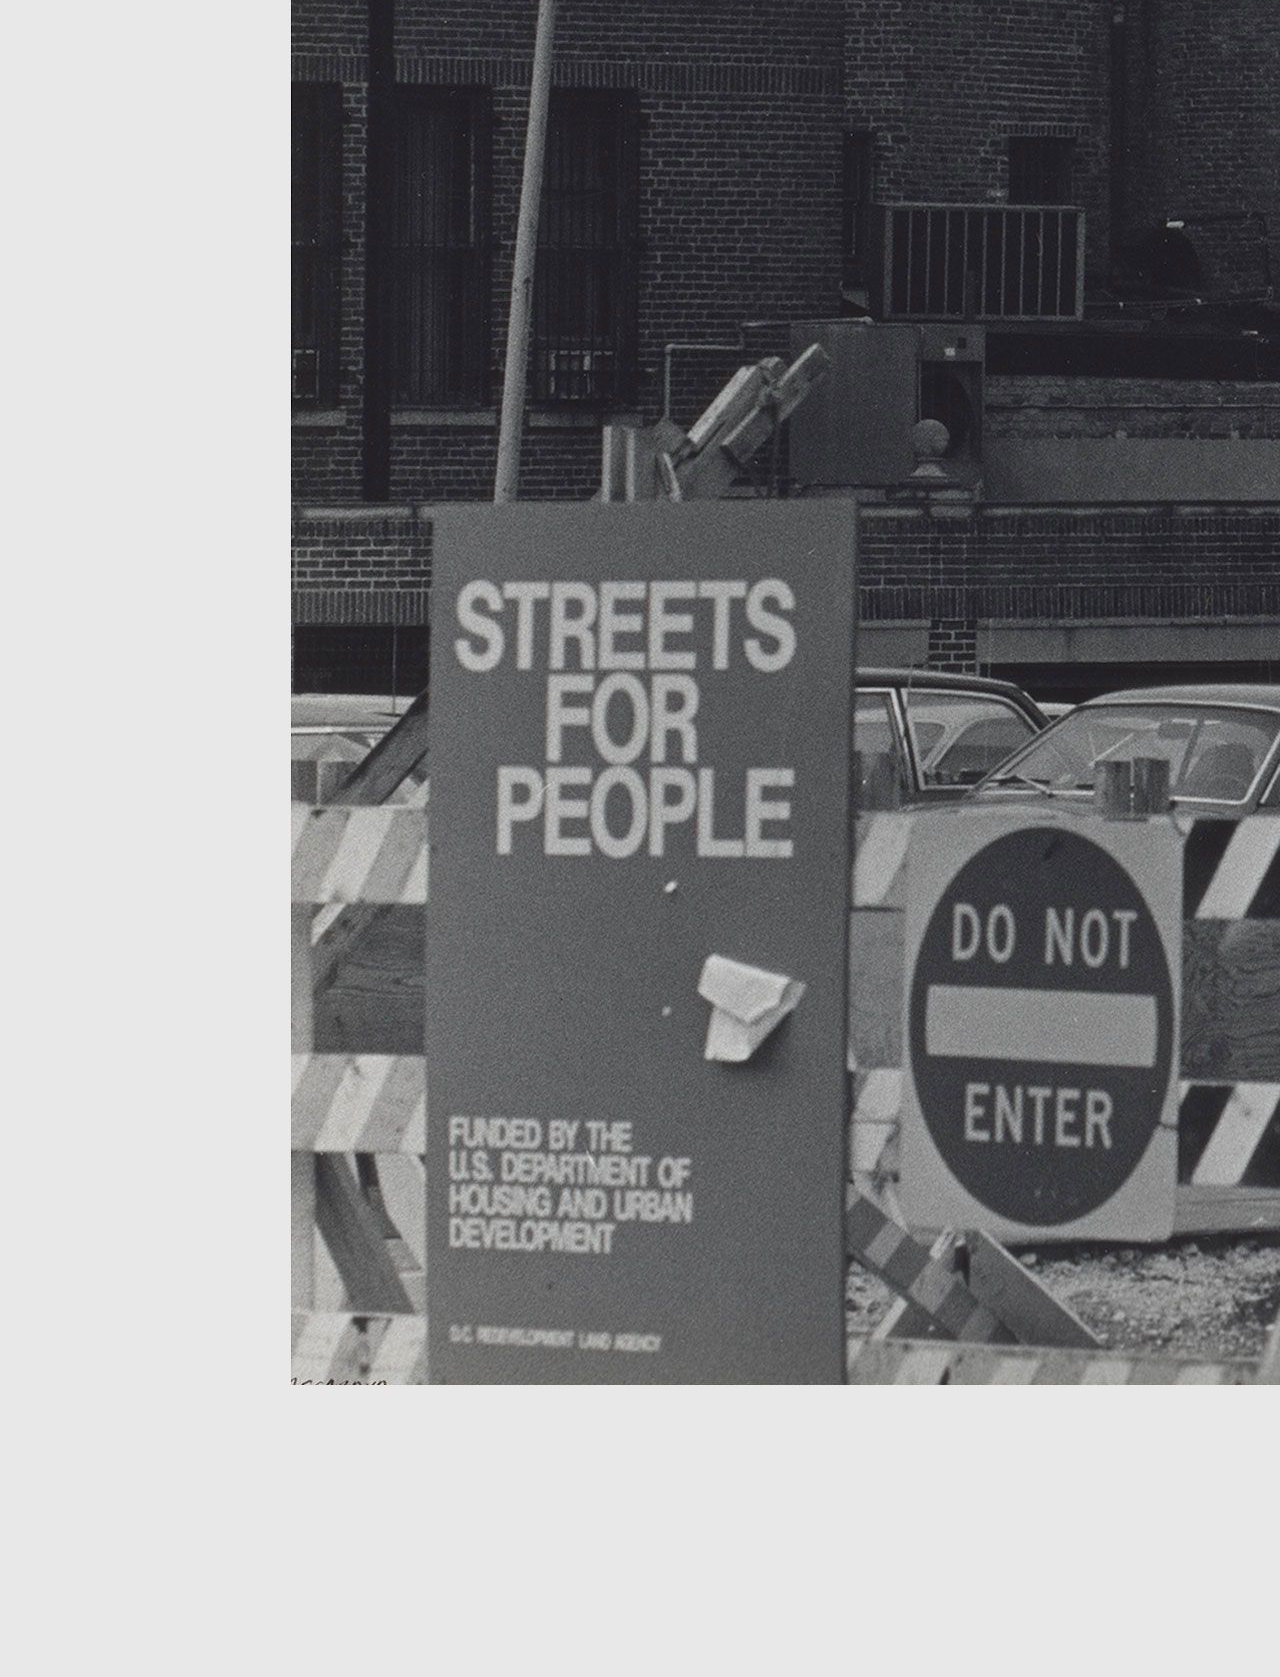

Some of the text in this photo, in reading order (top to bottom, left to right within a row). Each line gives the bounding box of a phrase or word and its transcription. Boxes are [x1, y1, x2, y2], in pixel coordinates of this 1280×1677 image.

[454, 578, 797, 672] STREETS
[546, 671, 700, 765] FOR
[497, 764, 796, 859] PEOPLE
[952, 904, 1139, 970] DO NOT
[449, 1116, 634, 1154] FUNDED BY THE
[963, 1082, 1113, 1150] ENTER
[449, 1149, 694, 1190] U.S. DEPARTMENT OF
[449, 1183, 694, 1224] HOUSING AND URBAN
[449, 1218, 616, 1253] DEVELOPMENT
